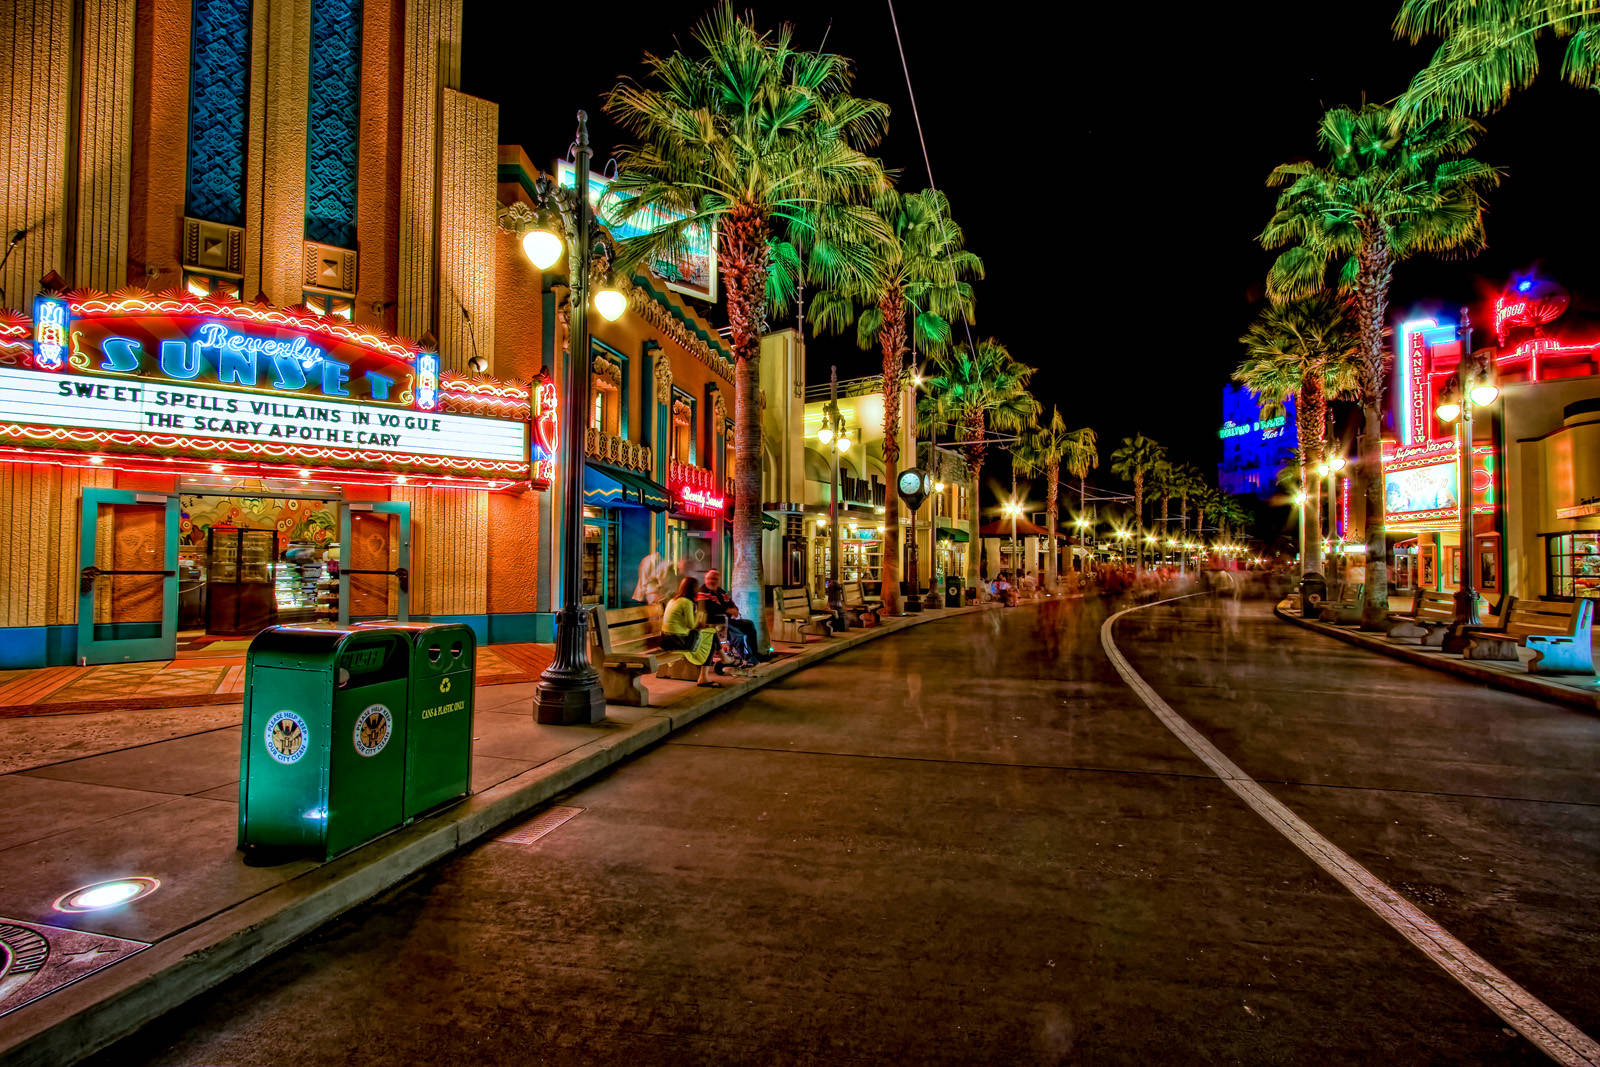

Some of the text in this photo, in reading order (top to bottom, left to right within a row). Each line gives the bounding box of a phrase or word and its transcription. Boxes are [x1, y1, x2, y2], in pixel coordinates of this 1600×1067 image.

[100, 336, 396, 401] SUNSET
[197, 323, 324, 369] Beverly
[1413, 330, 1422, 385] PLANET
[58, 380, 441, 432] SWEET SPELLS VILLAINS IN VOGUE
[144, 411, 402, 447] THE SCARY APOTHECARY
[1413, 390, 1425, 443] HOLLYW
[1393, 439, 1453, 462] Super Store
[267, 712, 284, 732] PLEASE
[267, 741, 278, 757] OUR
[277, 753, 290, 763] CITY
